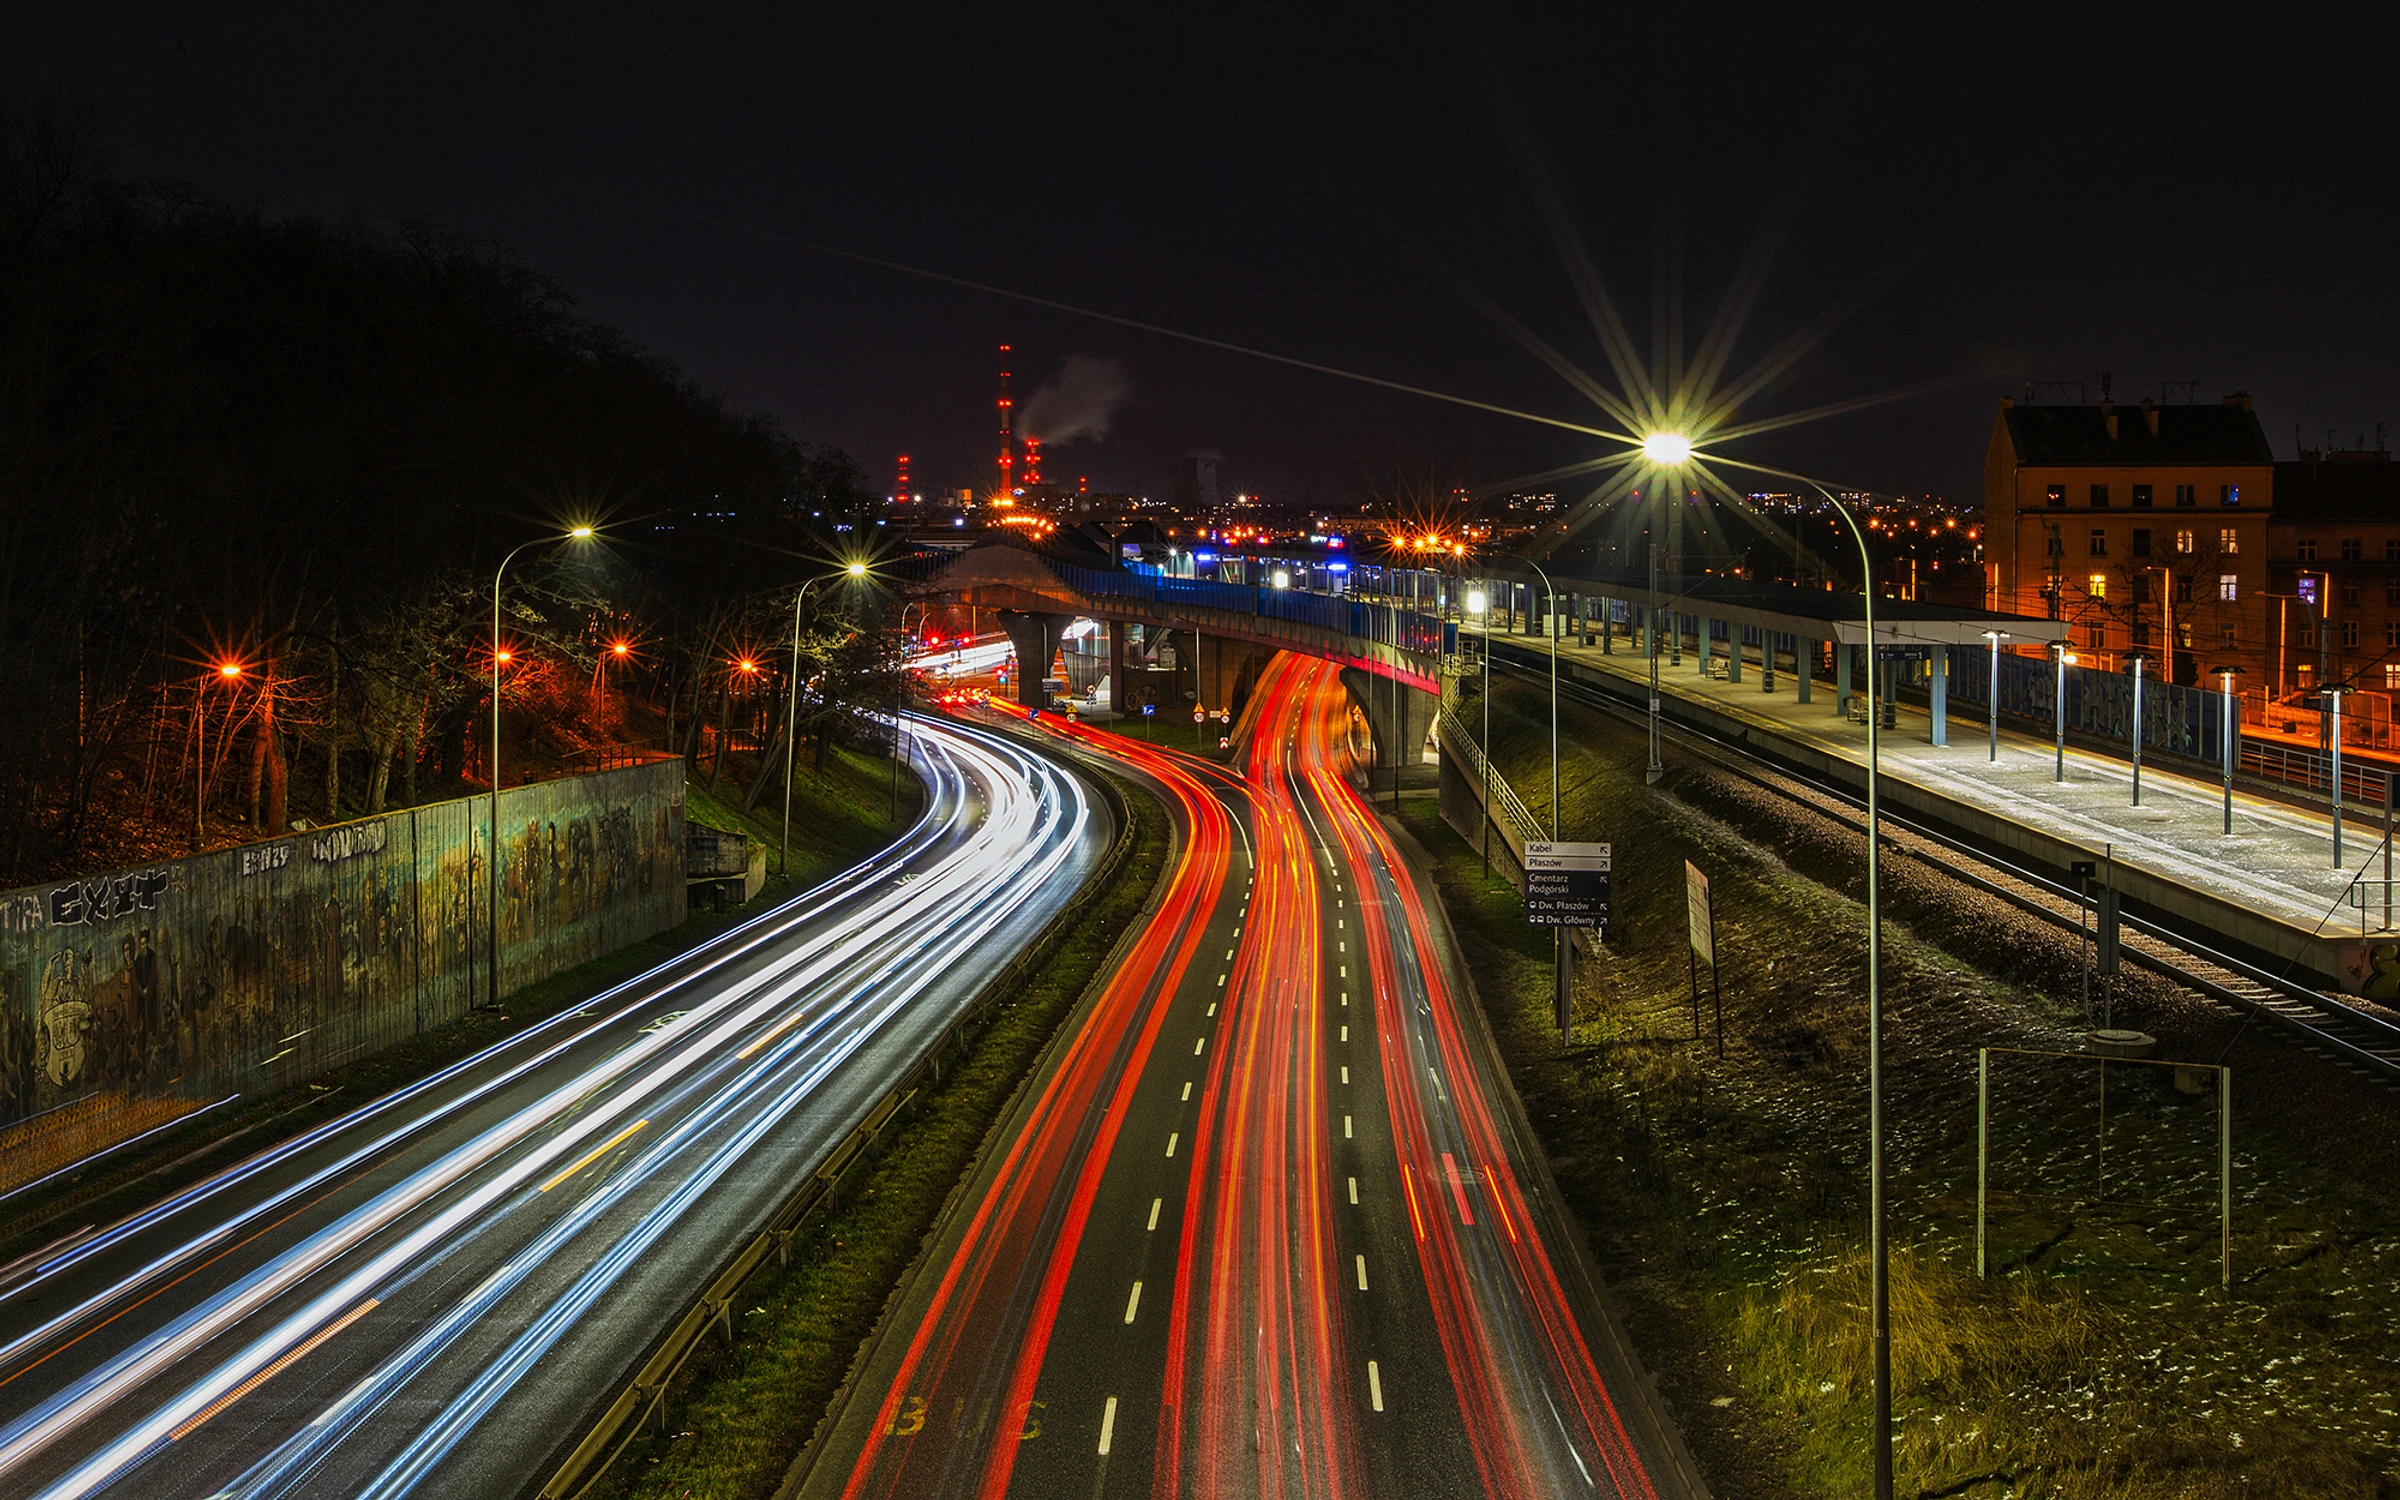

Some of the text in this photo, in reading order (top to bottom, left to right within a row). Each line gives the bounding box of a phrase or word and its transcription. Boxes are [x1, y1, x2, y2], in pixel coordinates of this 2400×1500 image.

[1529, 844, 1552, 852] Kabel
[1529, 858, 1562, 867] Płaszów
[1529, 873, 1568, 883] Cmentarz
[1529, 884, 1569, 896] Podgórski
[1538, 901, 1589, 909] Dw. Płaszów
[1546, 914, 1596, 927] Dw. Główny
